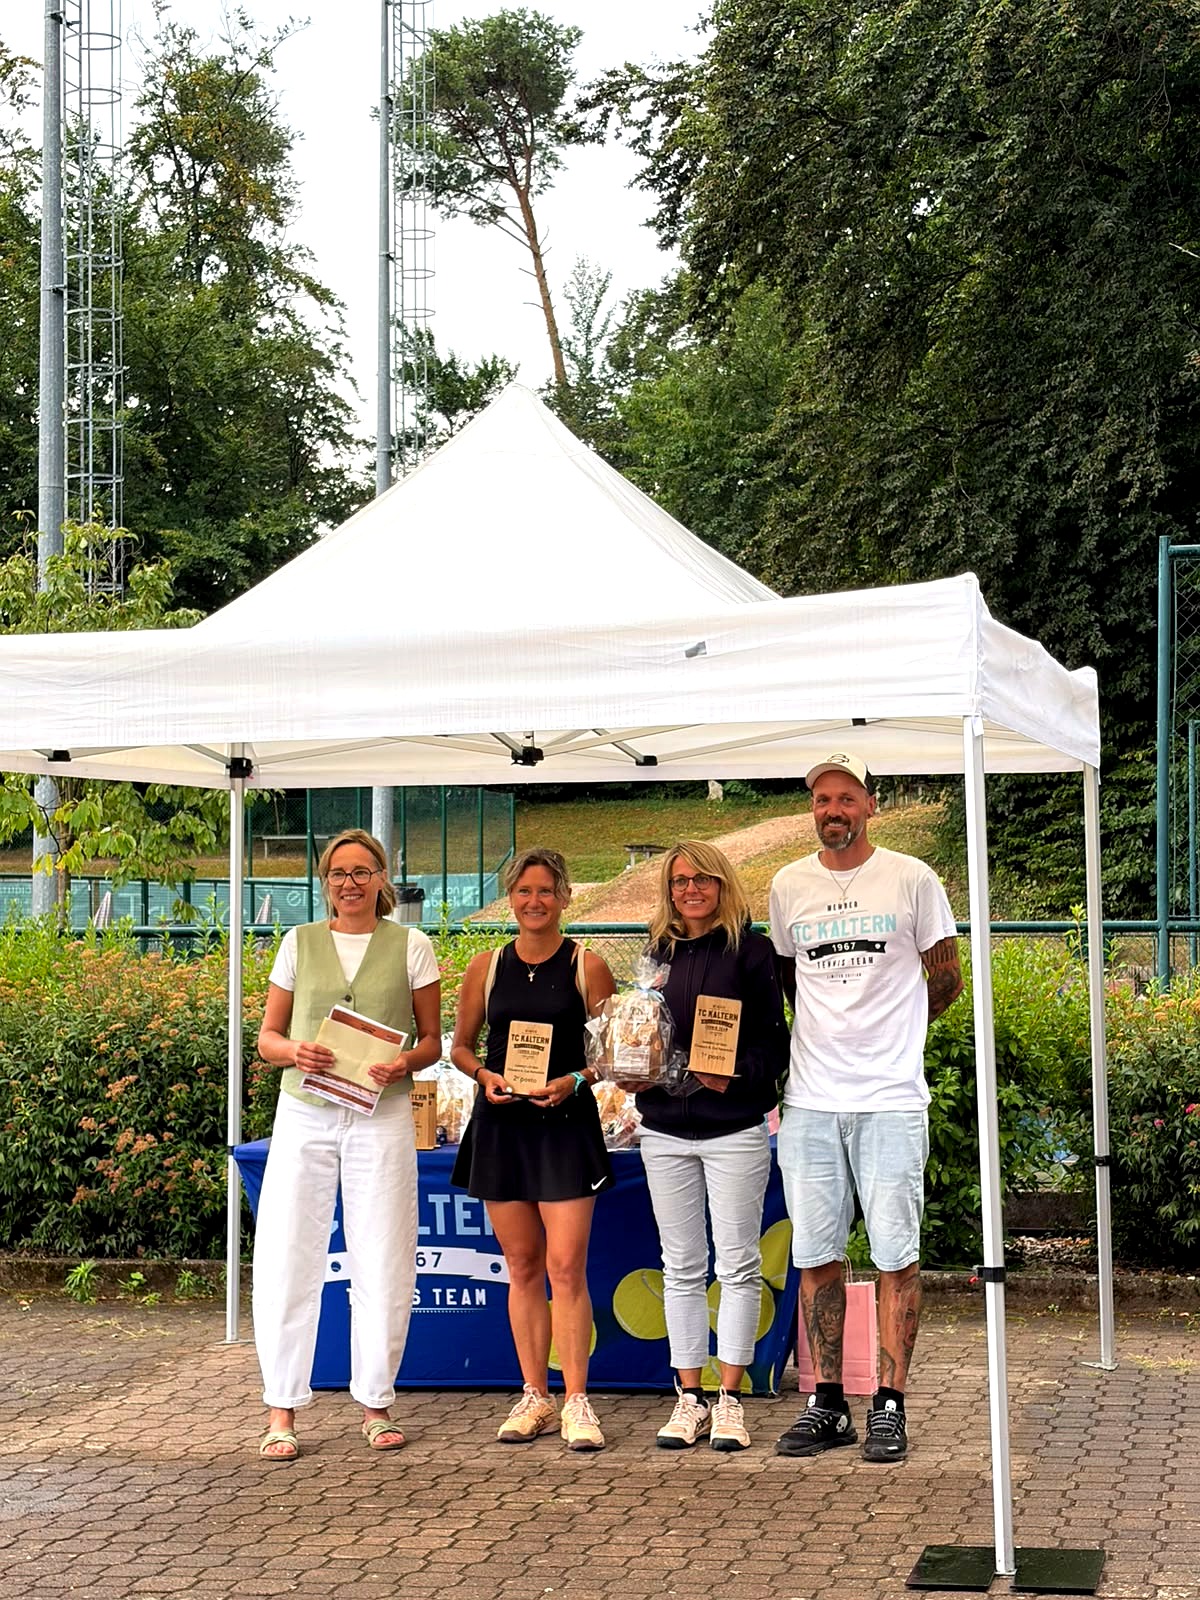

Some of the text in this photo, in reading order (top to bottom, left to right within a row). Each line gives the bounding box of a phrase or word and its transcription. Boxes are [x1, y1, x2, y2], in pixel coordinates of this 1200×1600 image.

[793, 914, 897, 943] TC KALTERN
[832, 942, 856, 952] 1967
[851, 957, 874, 966] TEAM
[698, 1009, 739, 1021] TC KALTERN
[511, 1034, 550, 1044] TC KALTERN
[416, 1252, 442, 1268] 67
[432, 1289, 487, 1305] TEAM
